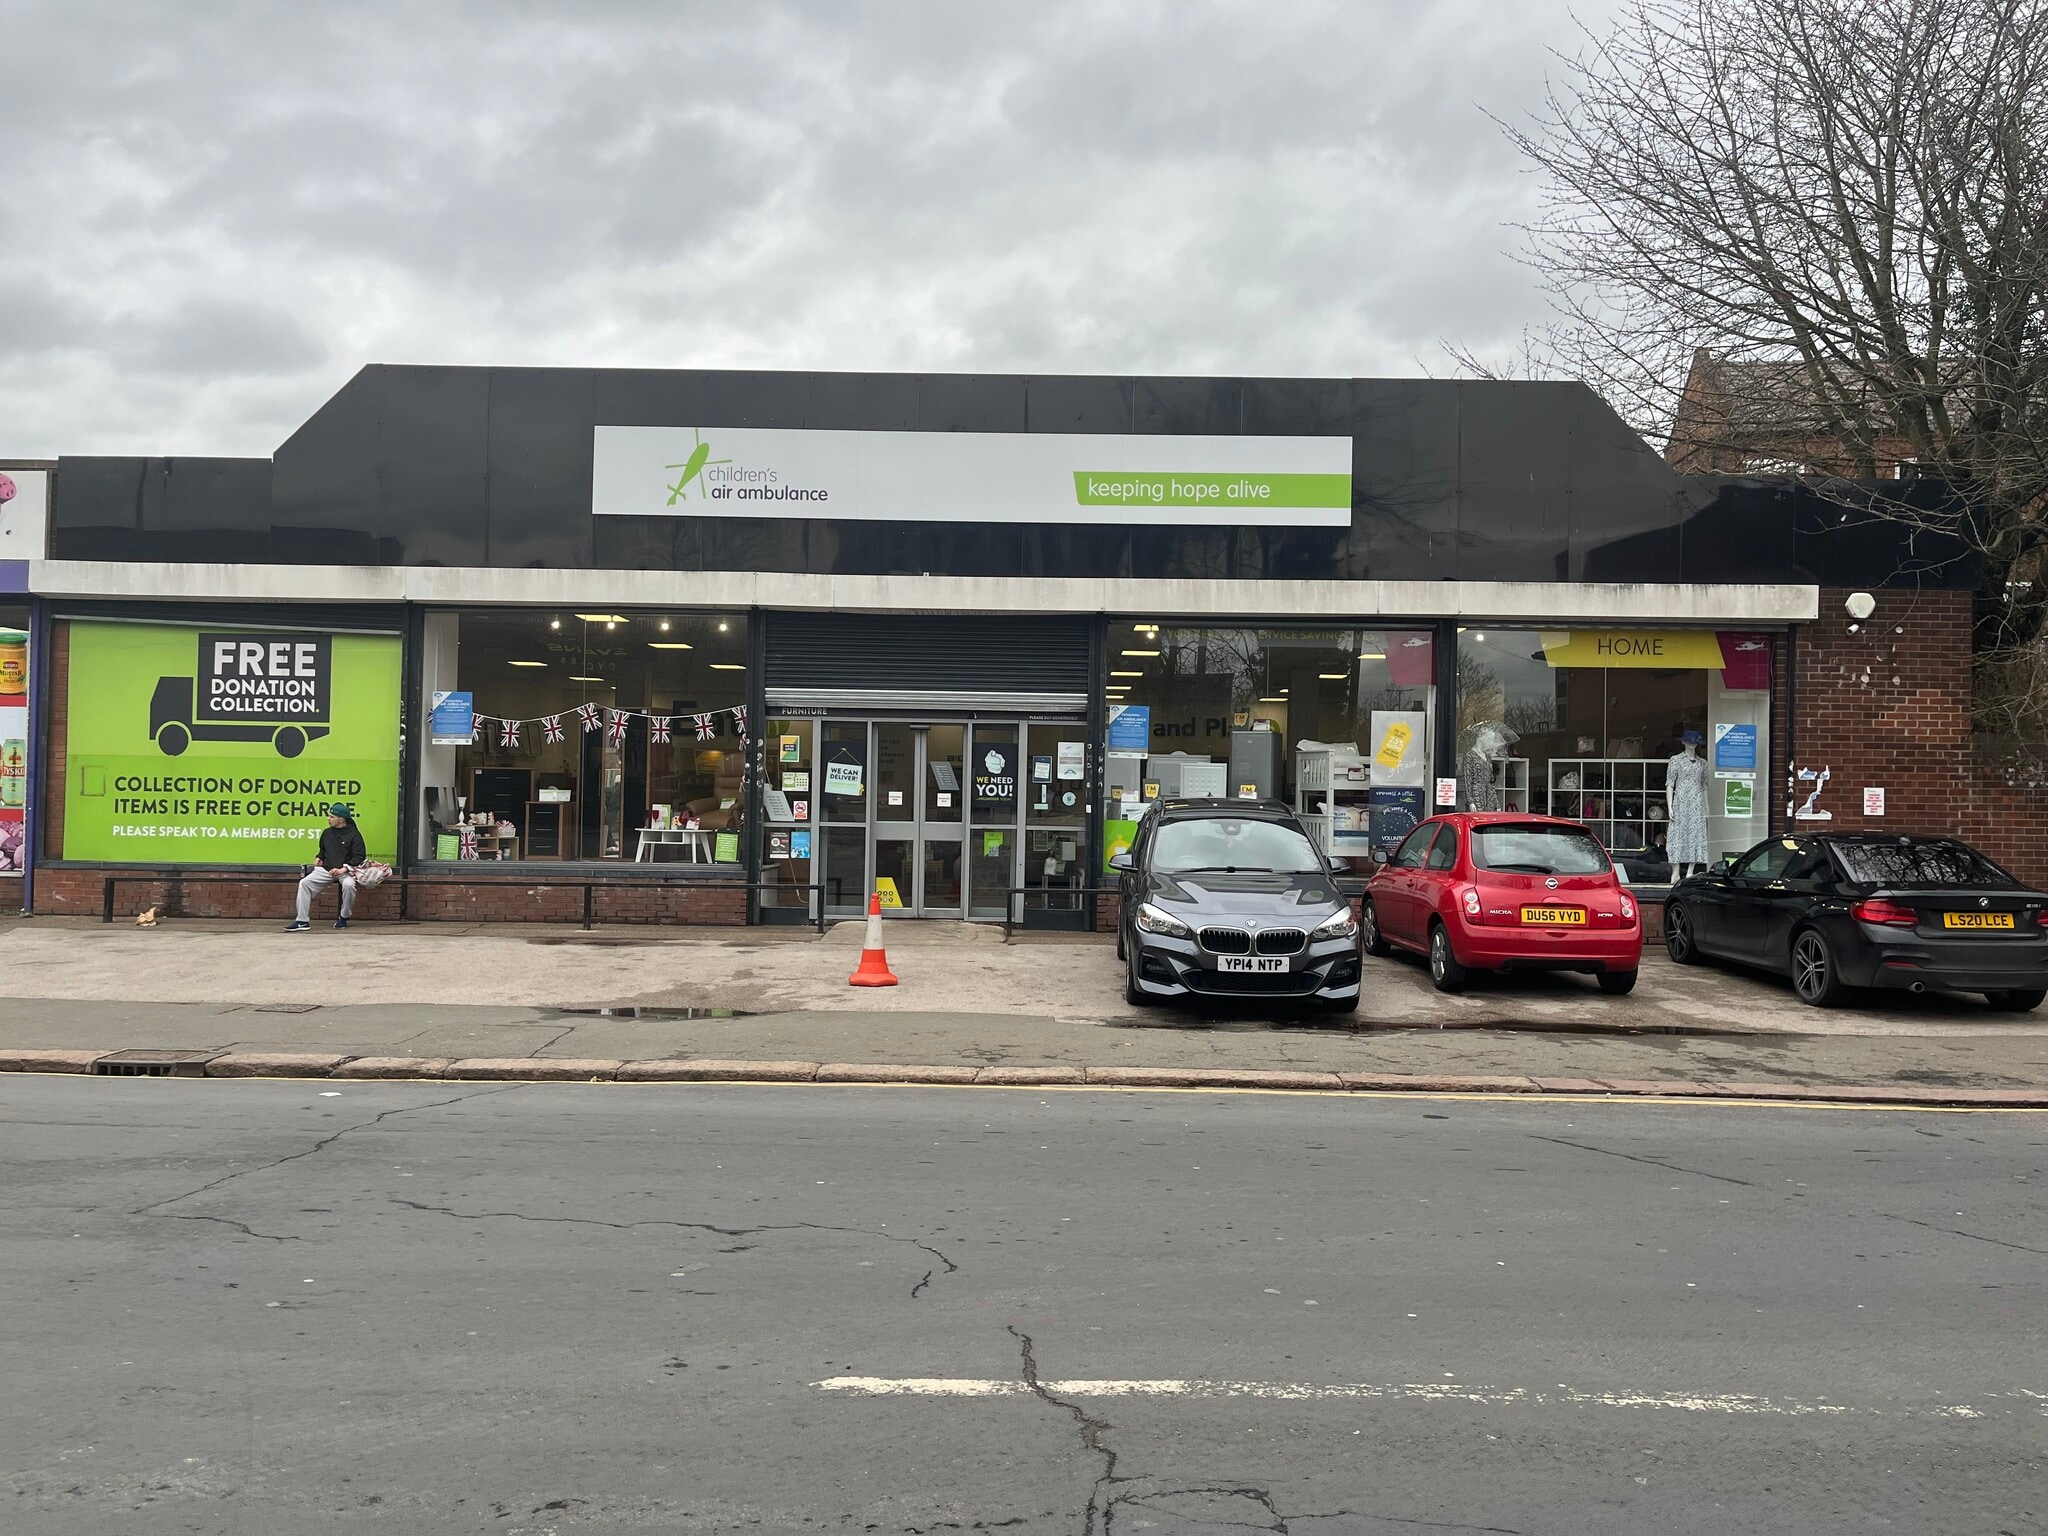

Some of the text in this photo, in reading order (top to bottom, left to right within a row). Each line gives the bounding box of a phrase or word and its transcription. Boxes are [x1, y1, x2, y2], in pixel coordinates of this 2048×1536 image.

[708, 466, 778, 483] children's
[711, 484, 828, 501] air ambulance
[1088, 477, 1271, 502] keeping hope alive
[1598, 638, 1664, 655] HOME
[214, 641, 317, 677] FREE
[211, 678, 315, 697] DONATION
[209, 697, 320, 713] COLLECTION.
[1153, 717, 1196, 736] and
[1205, 717, 1233, 737] Pl
[114, 776, 362, 796] COLLECTION OF DONATED
[976, 784, 1013, 797] YOU!
[114, 798, 169, 815] ITEMS
[173, 799, 190, 815] IS
[195, 800, 241, 816] FREE
[246, 800, 272, 816] OF
[112, 825, 156, 836] PLEASE
[159, 825, 198, 837] SPEAK
[201, 826, 218, 838] TO
[220, 827, 228, 838] A
[231, 827, 285, 839] MEMBER
[288, 828, 305, 839] OF
[1526, 910, 1580, 921] DU56 VYD
[1950, 915, 2008, 926] LS20 LCE
[1225, 958, 1282, 970] YP14 NTP
